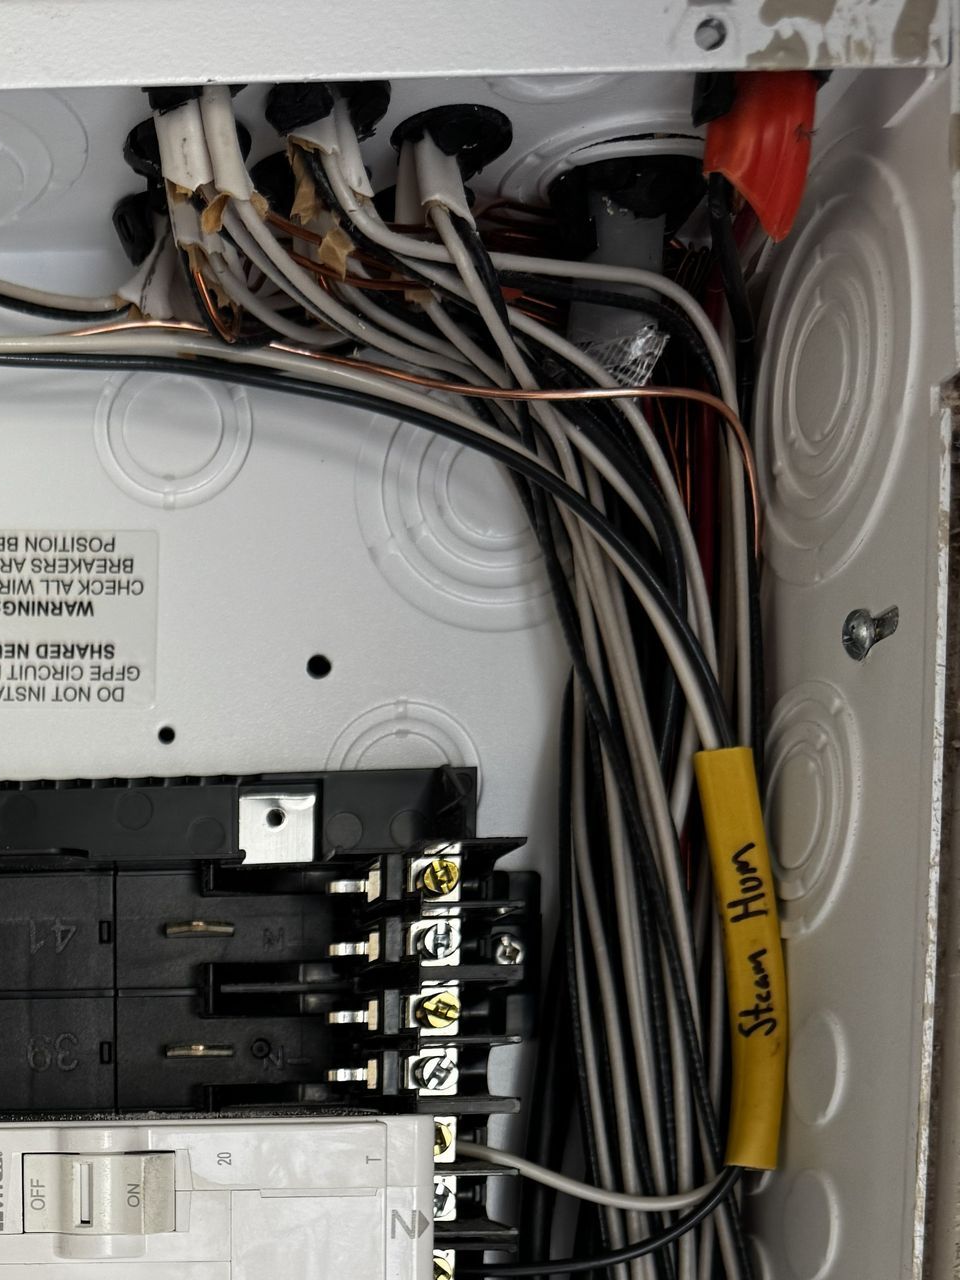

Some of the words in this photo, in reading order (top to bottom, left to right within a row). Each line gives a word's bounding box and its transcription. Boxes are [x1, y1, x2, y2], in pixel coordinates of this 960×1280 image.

[25, 537, 115, 552] POSITION
[31, 558, 133, 573] BREAKERS
[40, 579, 73, 595] ALL
[79, 580, 144, 595] CHECK
[36, 644, 114, 659] SHARED
[7, 665, 83, 681] CIRCUIT
[90, 665, 140, 681] GFPE
[52, 686, 90, 702] NOT
[97, 687, 124, 702] DO
[217, 1152, 231, 1165] 20
[31, 1179, 45, 1210] OFF
[127, 1184, 140, 1207] ON
